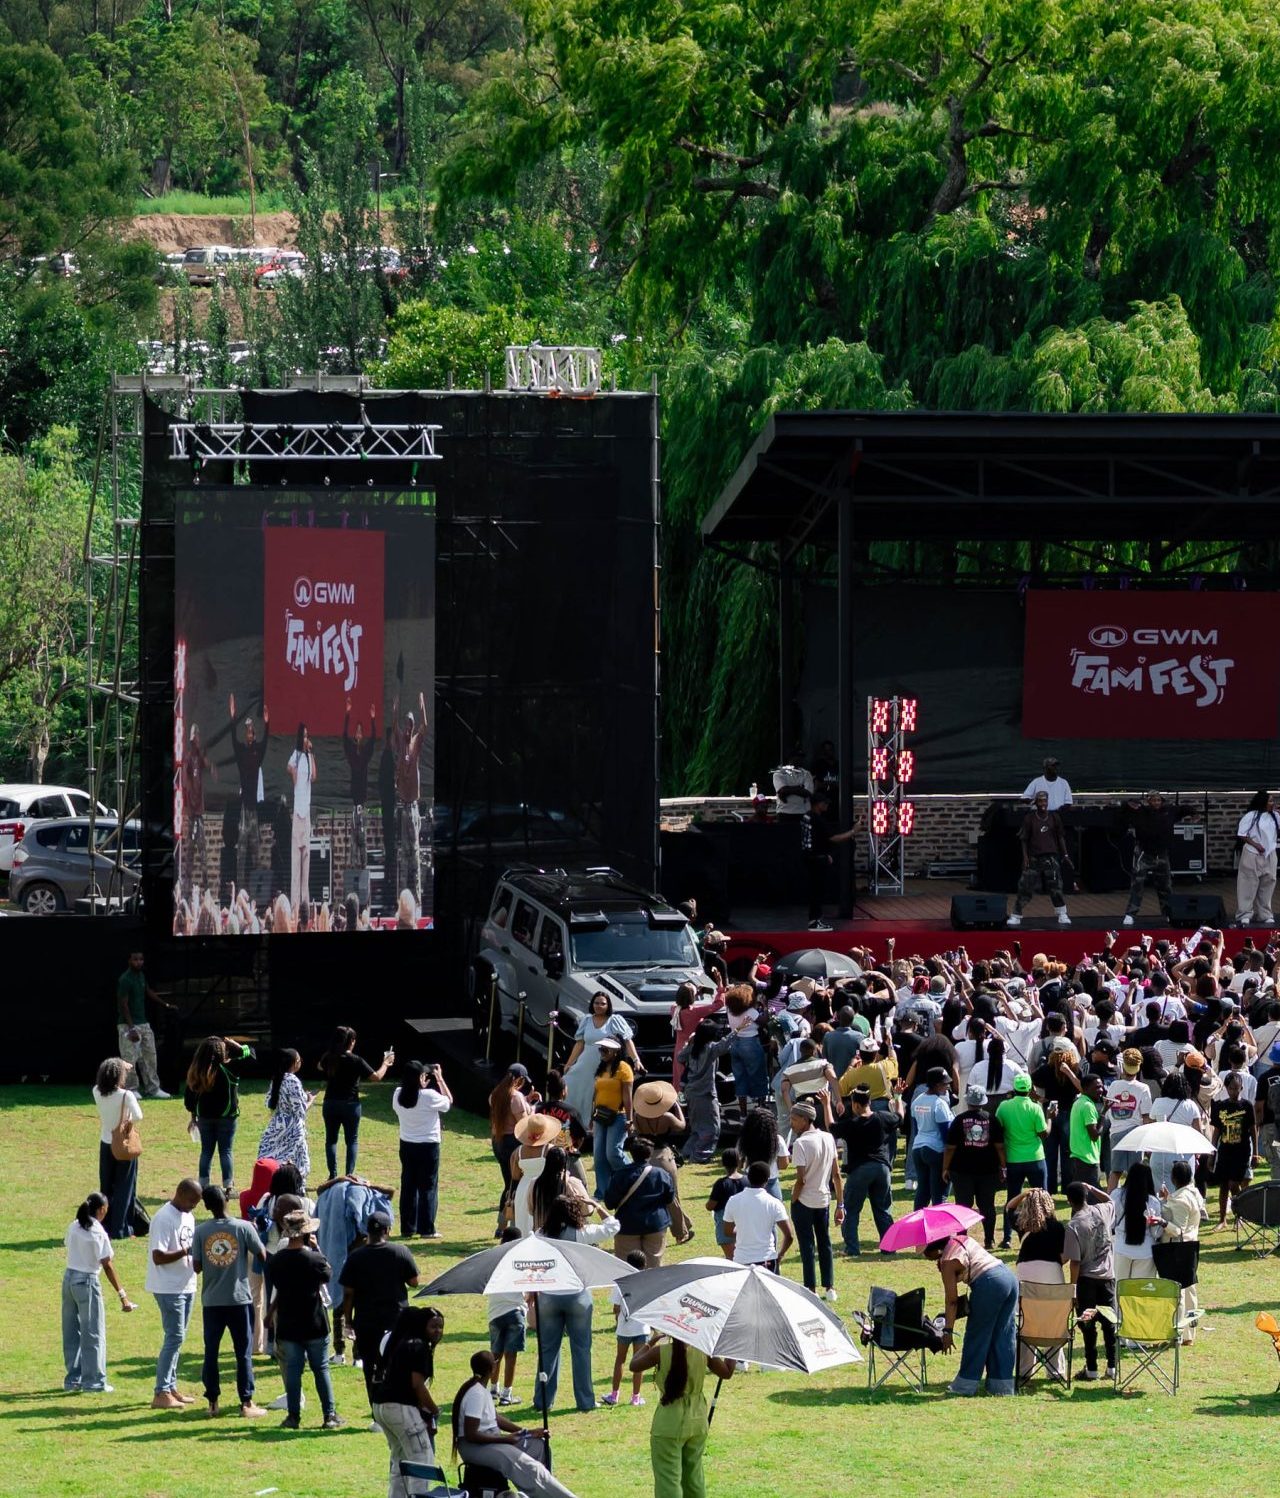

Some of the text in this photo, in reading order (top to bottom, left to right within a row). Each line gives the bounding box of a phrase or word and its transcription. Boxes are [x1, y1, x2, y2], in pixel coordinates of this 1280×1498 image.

[314, 582, 355, 604] GWM
[286, 619, 363, 691] FAM FEST
[1133, 629, 1218, 645] GWM
[1071, 655, 1235, 707] FAM FEST
